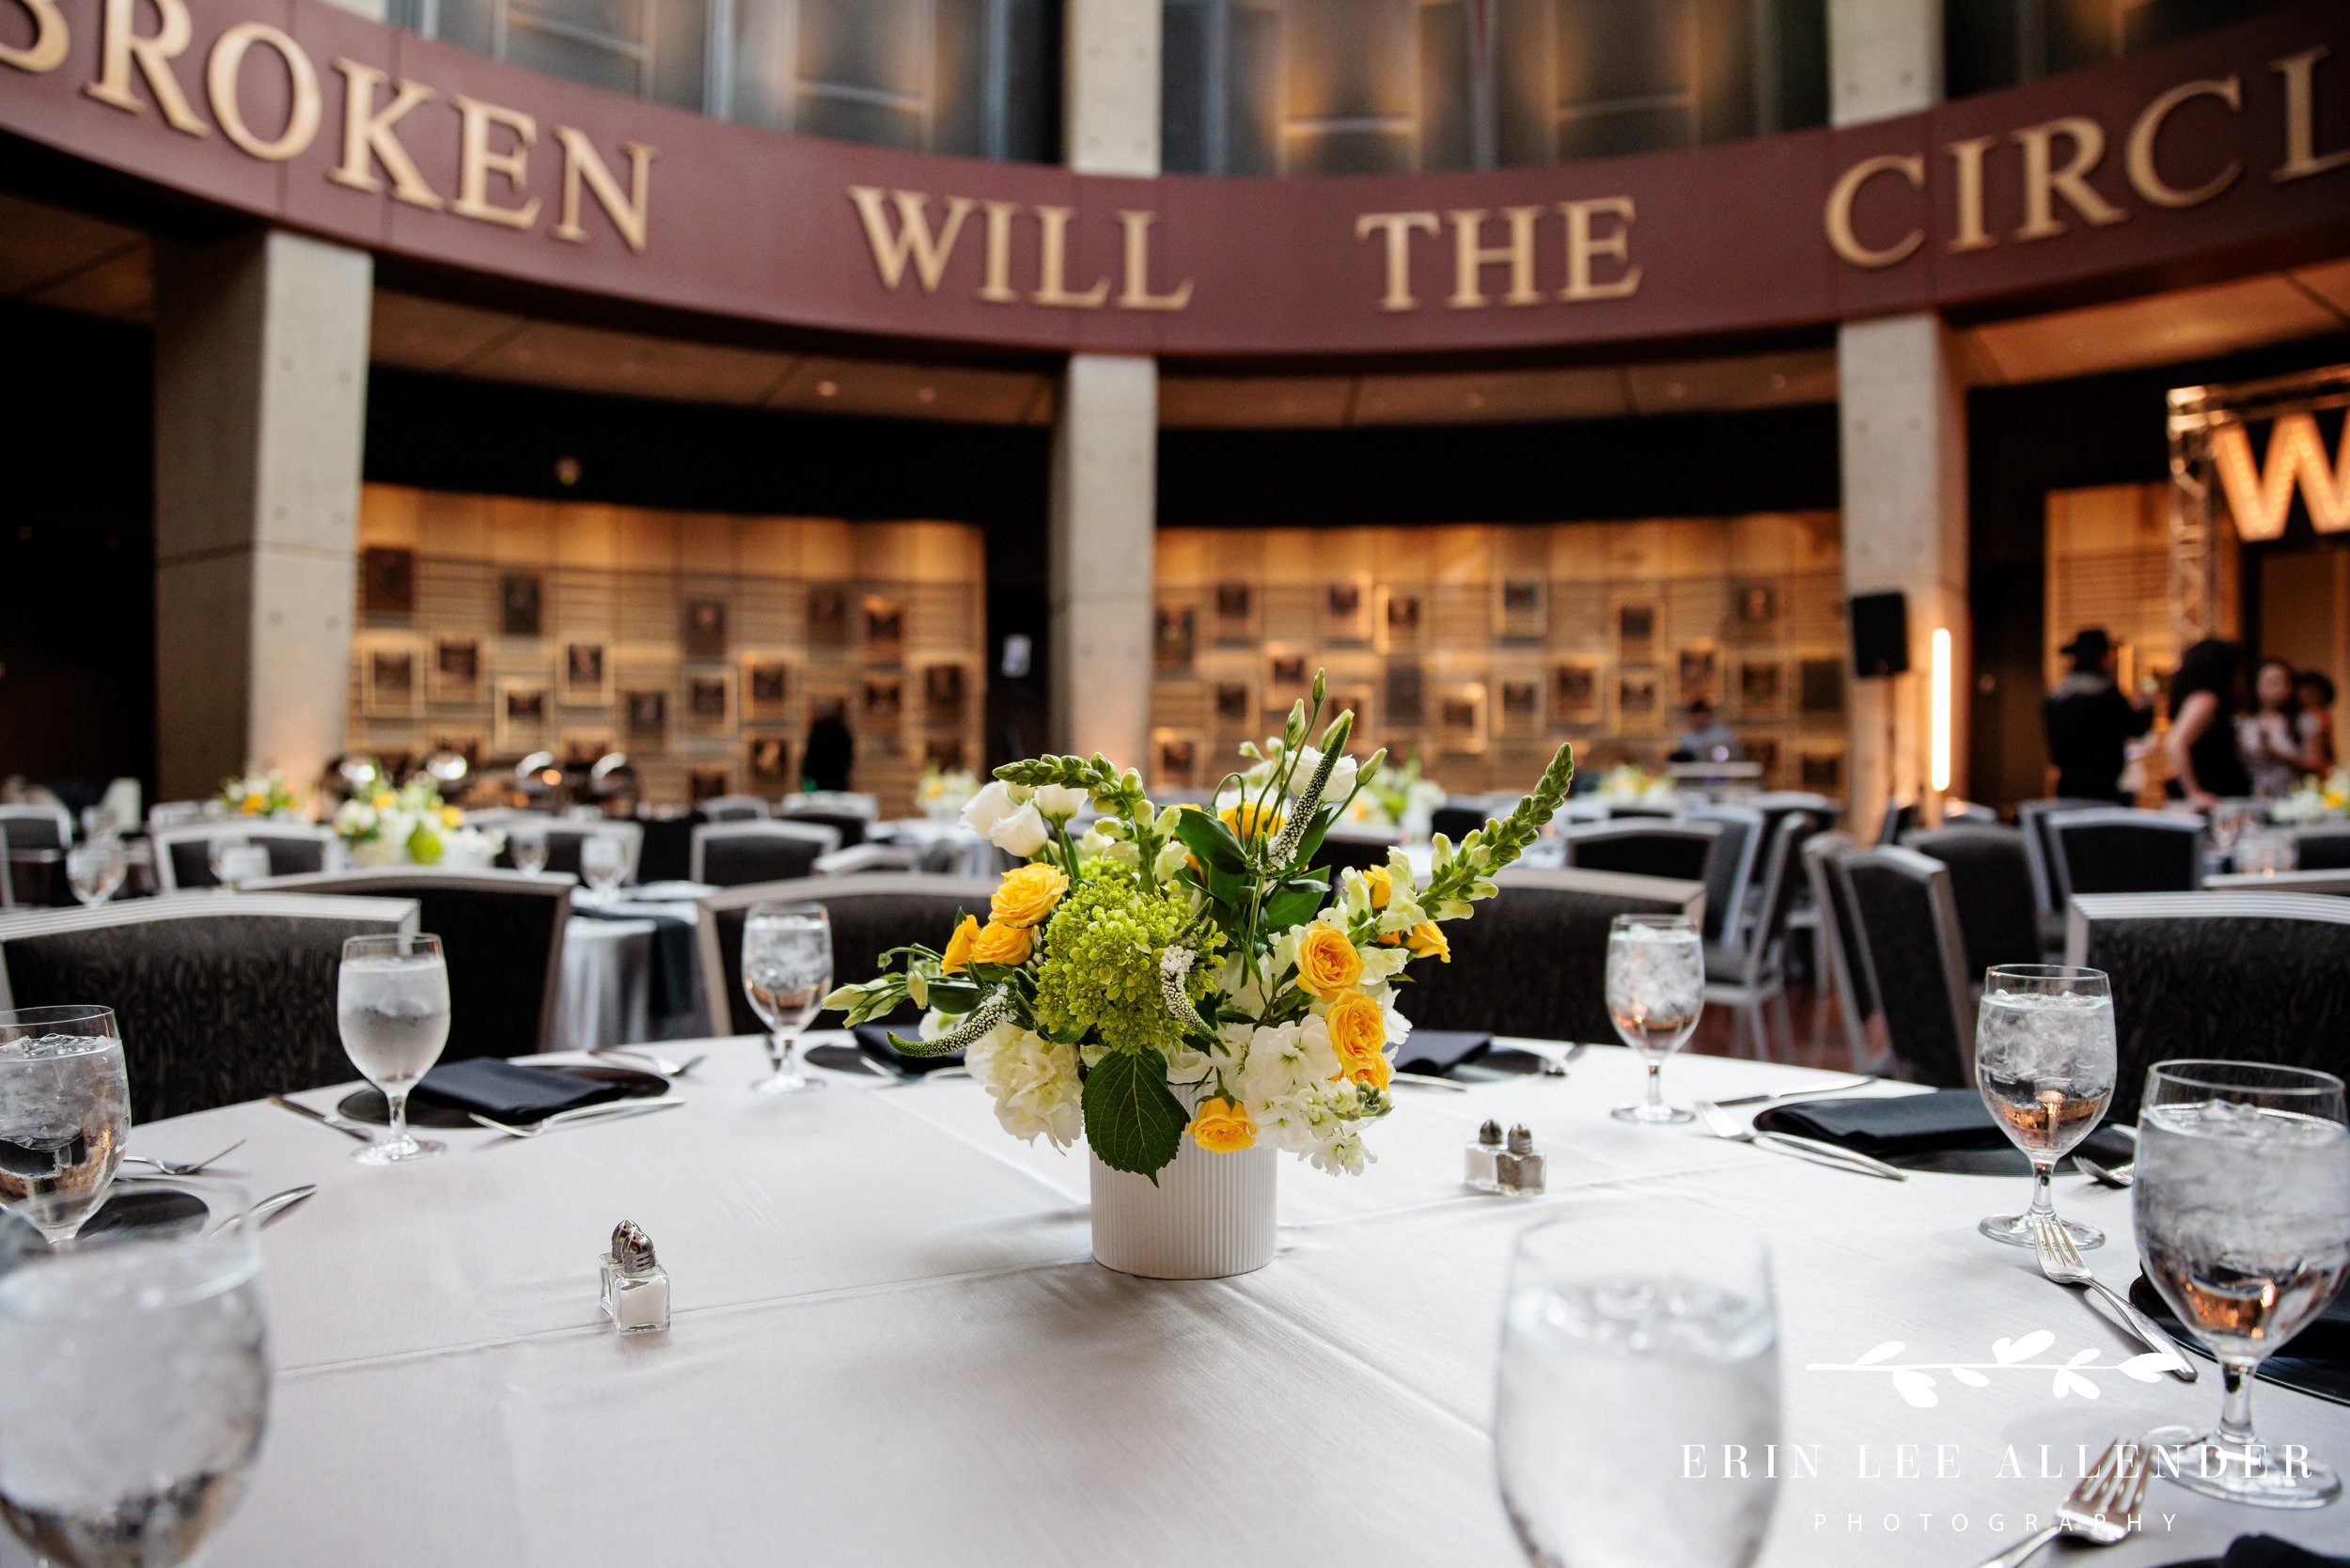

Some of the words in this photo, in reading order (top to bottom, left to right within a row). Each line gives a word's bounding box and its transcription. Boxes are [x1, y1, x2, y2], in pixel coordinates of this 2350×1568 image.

[848, 186, 1194, 311] WILL
[1355, 196, 1643, 312] THE
[1825, 45, 2350, 268] CIRCL
